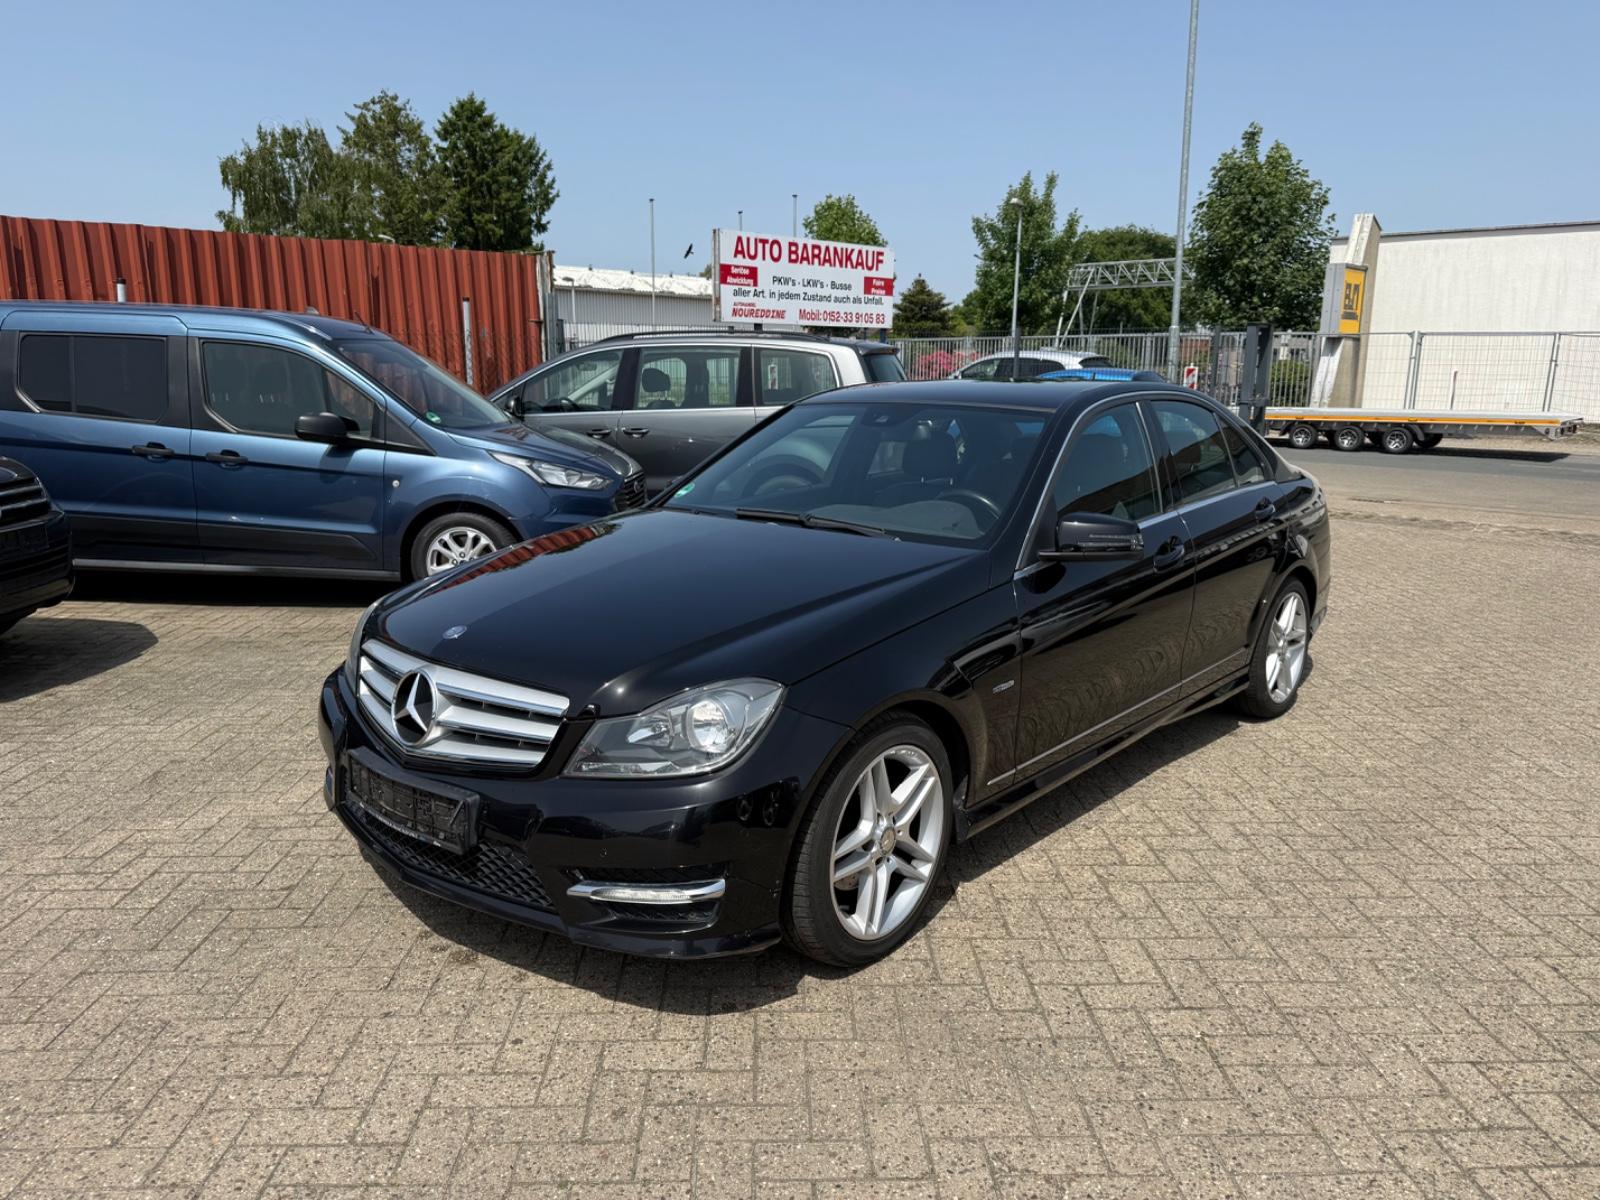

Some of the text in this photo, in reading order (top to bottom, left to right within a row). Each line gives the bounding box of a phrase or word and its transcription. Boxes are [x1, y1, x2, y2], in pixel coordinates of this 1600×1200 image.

[733, 235, 885, 271] AUTO BARANKAUF
[772, 275, 852, 291] PKW's LKW's Busse
[733, 288, 751, 297] aller
[769, 289, 776, 299] in
[777, 290, 801, 302] jedem
[802, 292, 832, 303] Zustand
[833, 294, 851, 304] auch
[852, 295, 863, 304] als
[731, 307, 786, 320] NOUREDDINE
[799, 308, 823, 321] Mobil:
